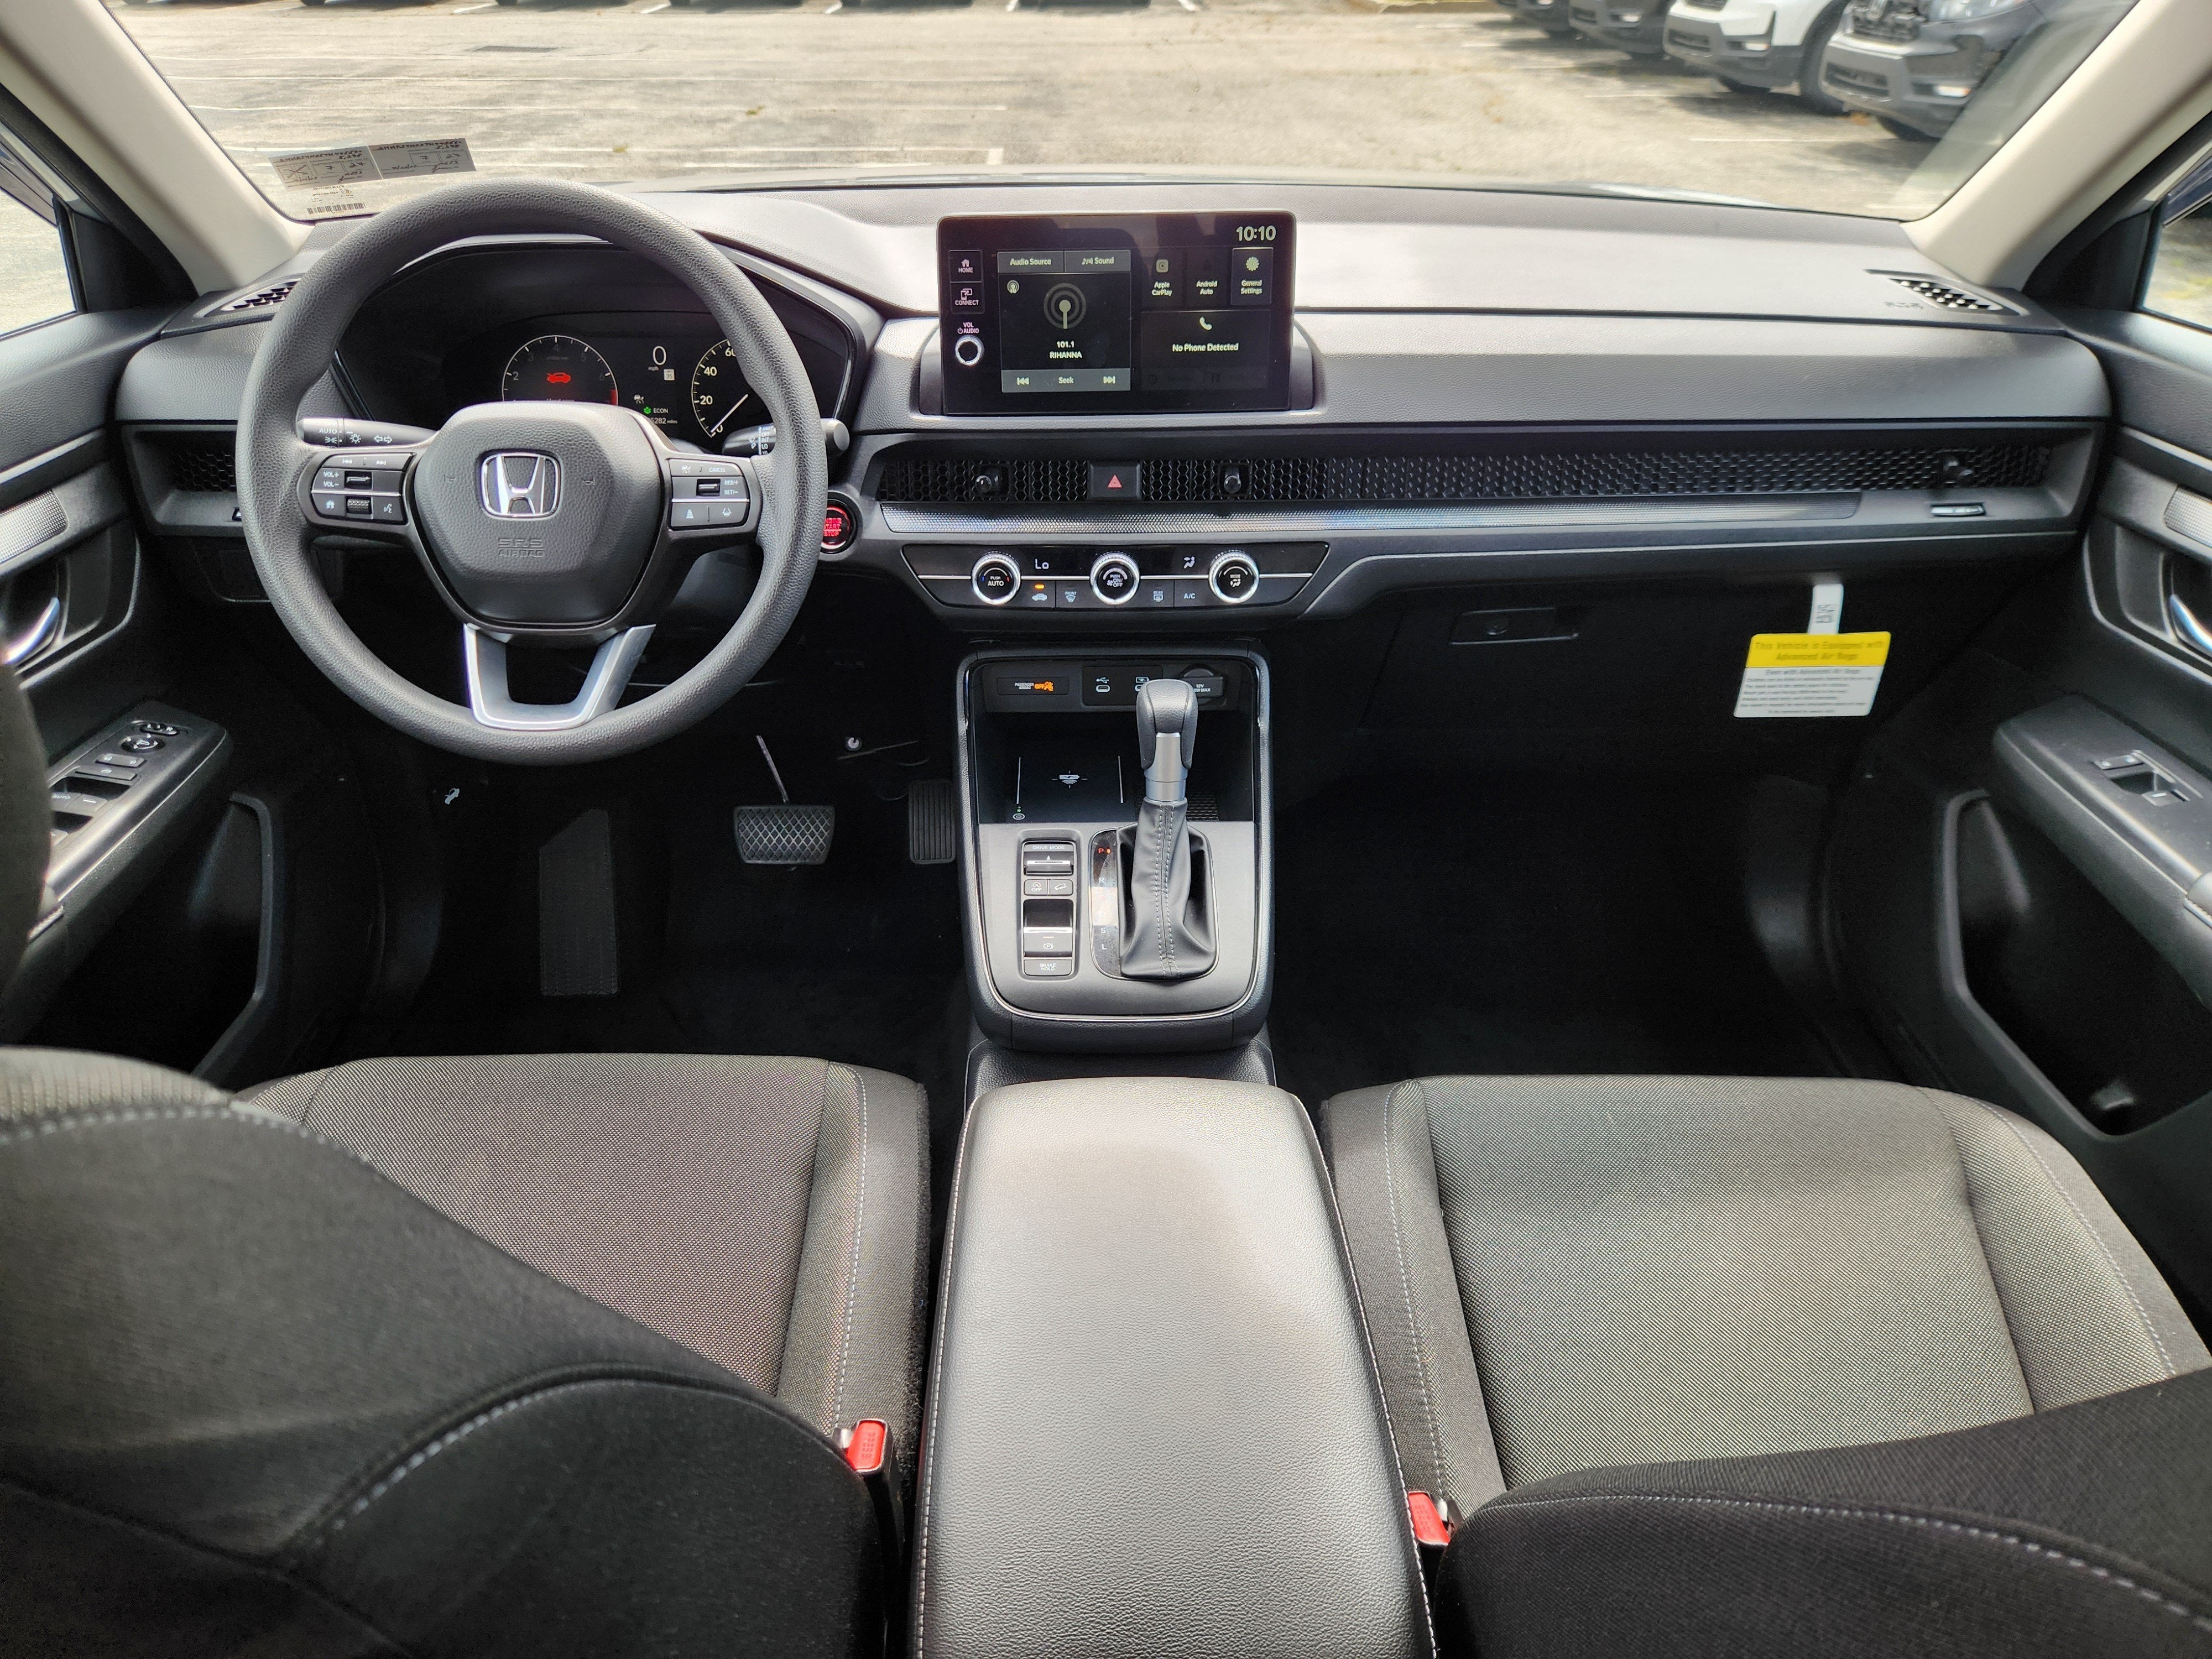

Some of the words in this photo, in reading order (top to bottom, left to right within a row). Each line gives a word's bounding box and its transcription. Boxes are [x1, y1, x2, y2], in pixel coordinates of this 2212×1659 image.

[1236, 226, 1276, 241] 10:10
[1240, 287, 1262, 295] Settings
[1172, 343, 1183, 352] No
[1184, 343, 1206, 352] Phone
[1207, 342, 1239, 351] Detected
[653, 346, 667, 366] 0
[1049, 351, 1082, 359] RIHANNA
[703, 366, 717, 376] 40
[513, 372, 519, 380] 2
[700, 395, 713, 405] 20
[498, 538, 543, 547] SRS
[498, 549, 545, 558] AIRBAG
